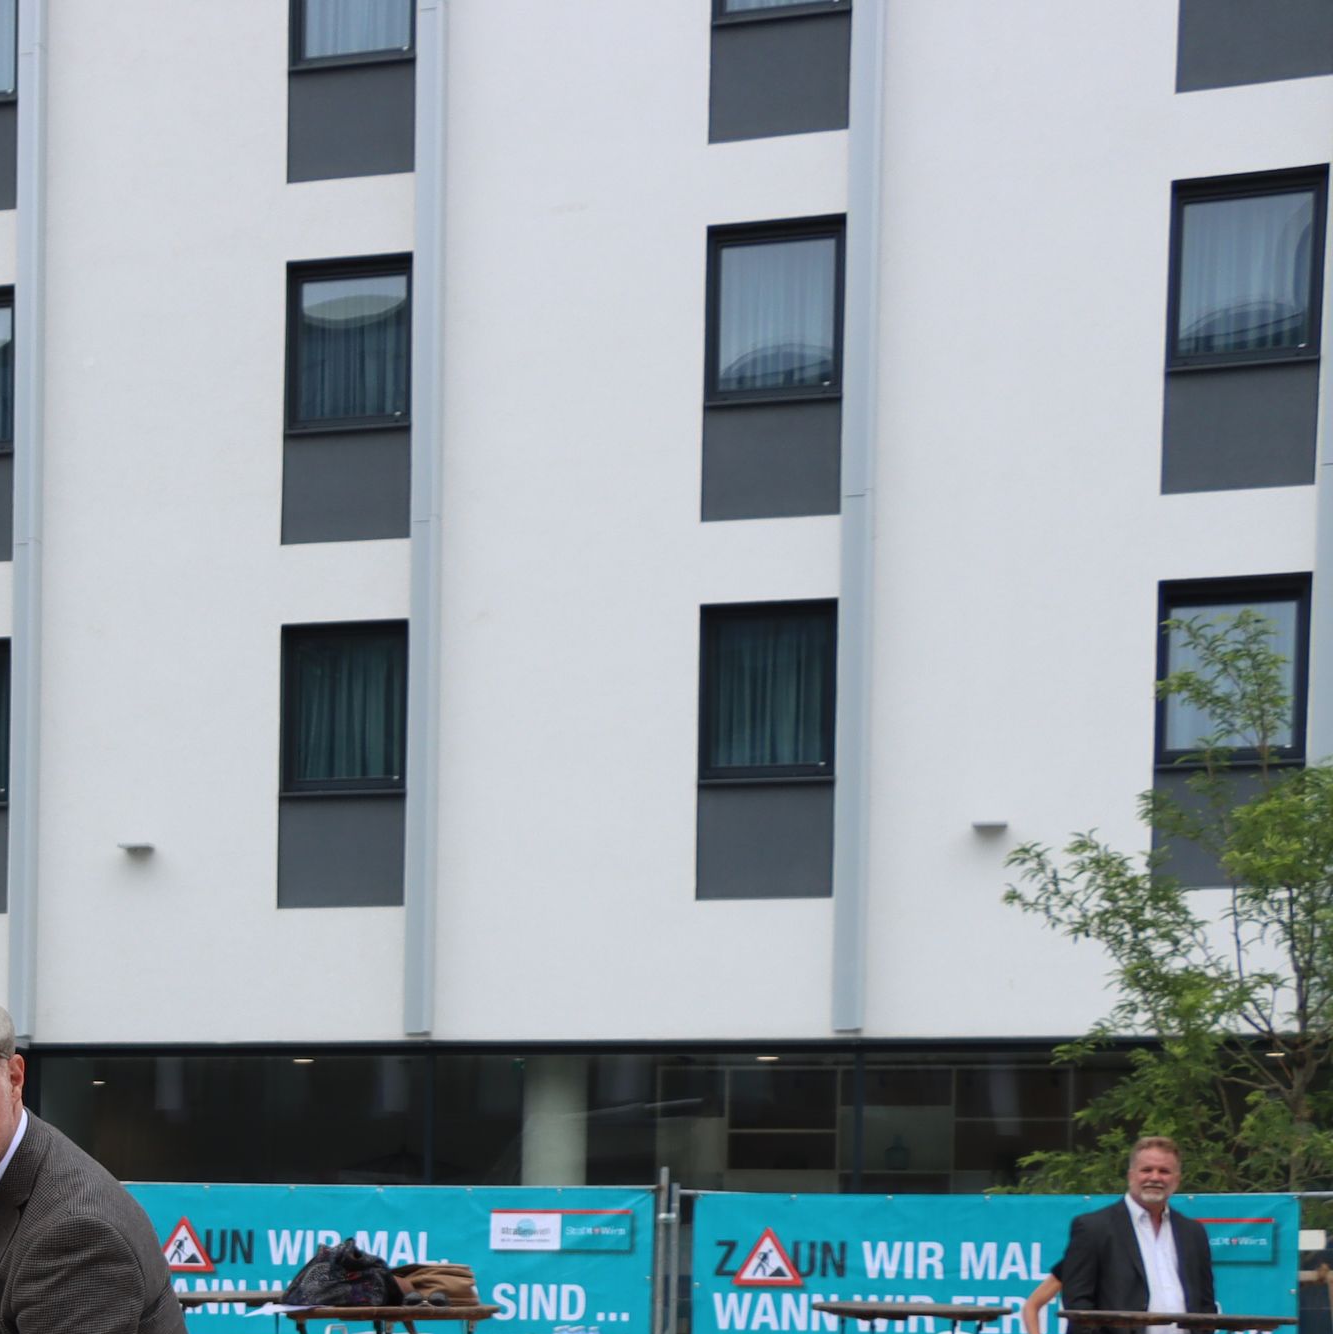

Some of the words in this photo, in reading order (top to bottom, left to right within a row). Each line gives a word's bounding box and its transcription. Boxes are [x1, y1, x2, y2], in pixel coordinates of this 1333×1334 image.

[862, 1241, 945, 1280] WIR
[492, 1282, 587, 1322] SIND
[713, 1292, 839, 1332] WANN
